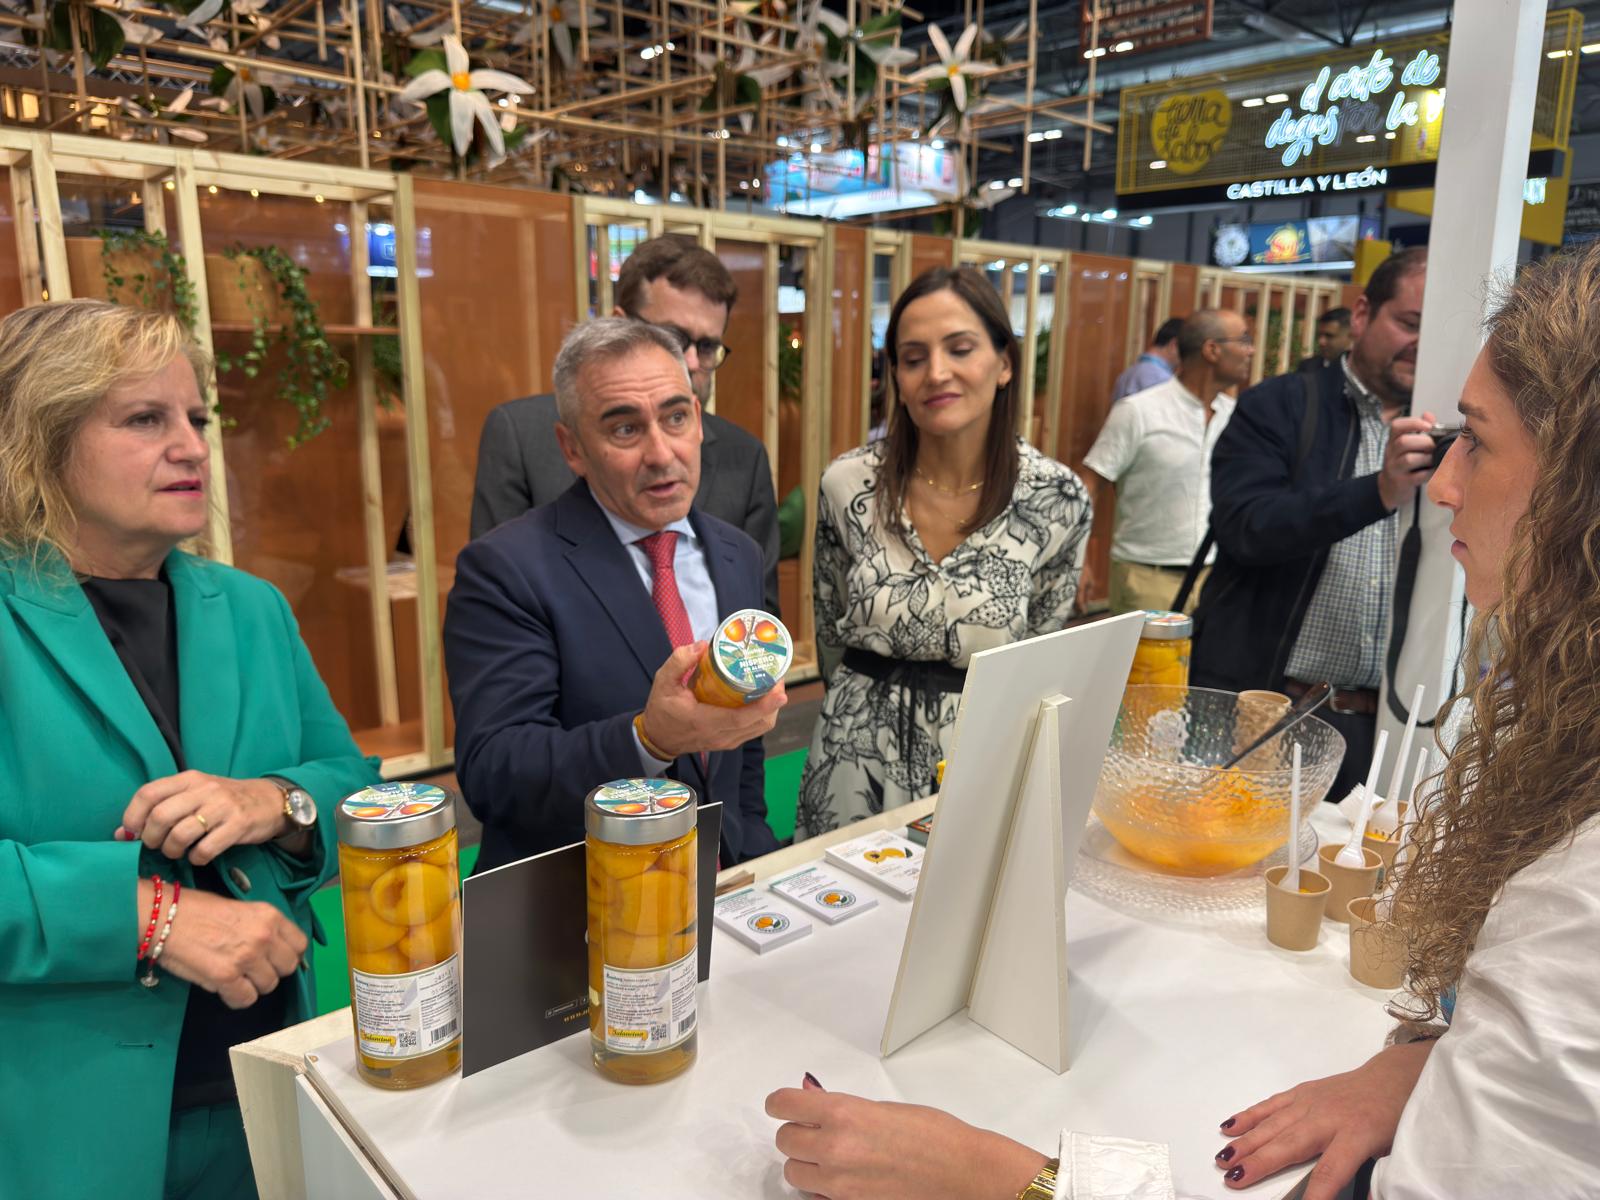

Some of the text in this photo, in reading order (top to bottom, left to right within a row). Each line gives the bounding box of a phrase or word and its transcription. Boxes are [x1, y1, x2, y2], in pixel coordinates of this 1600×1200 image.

[1328, 49, 1394, 102] arte
[1401, 50, 1440, 86] de
[1385, 91, 1419, 130] la
[1227, 166, 1387, 200] CASTILLA Y LEÓN
